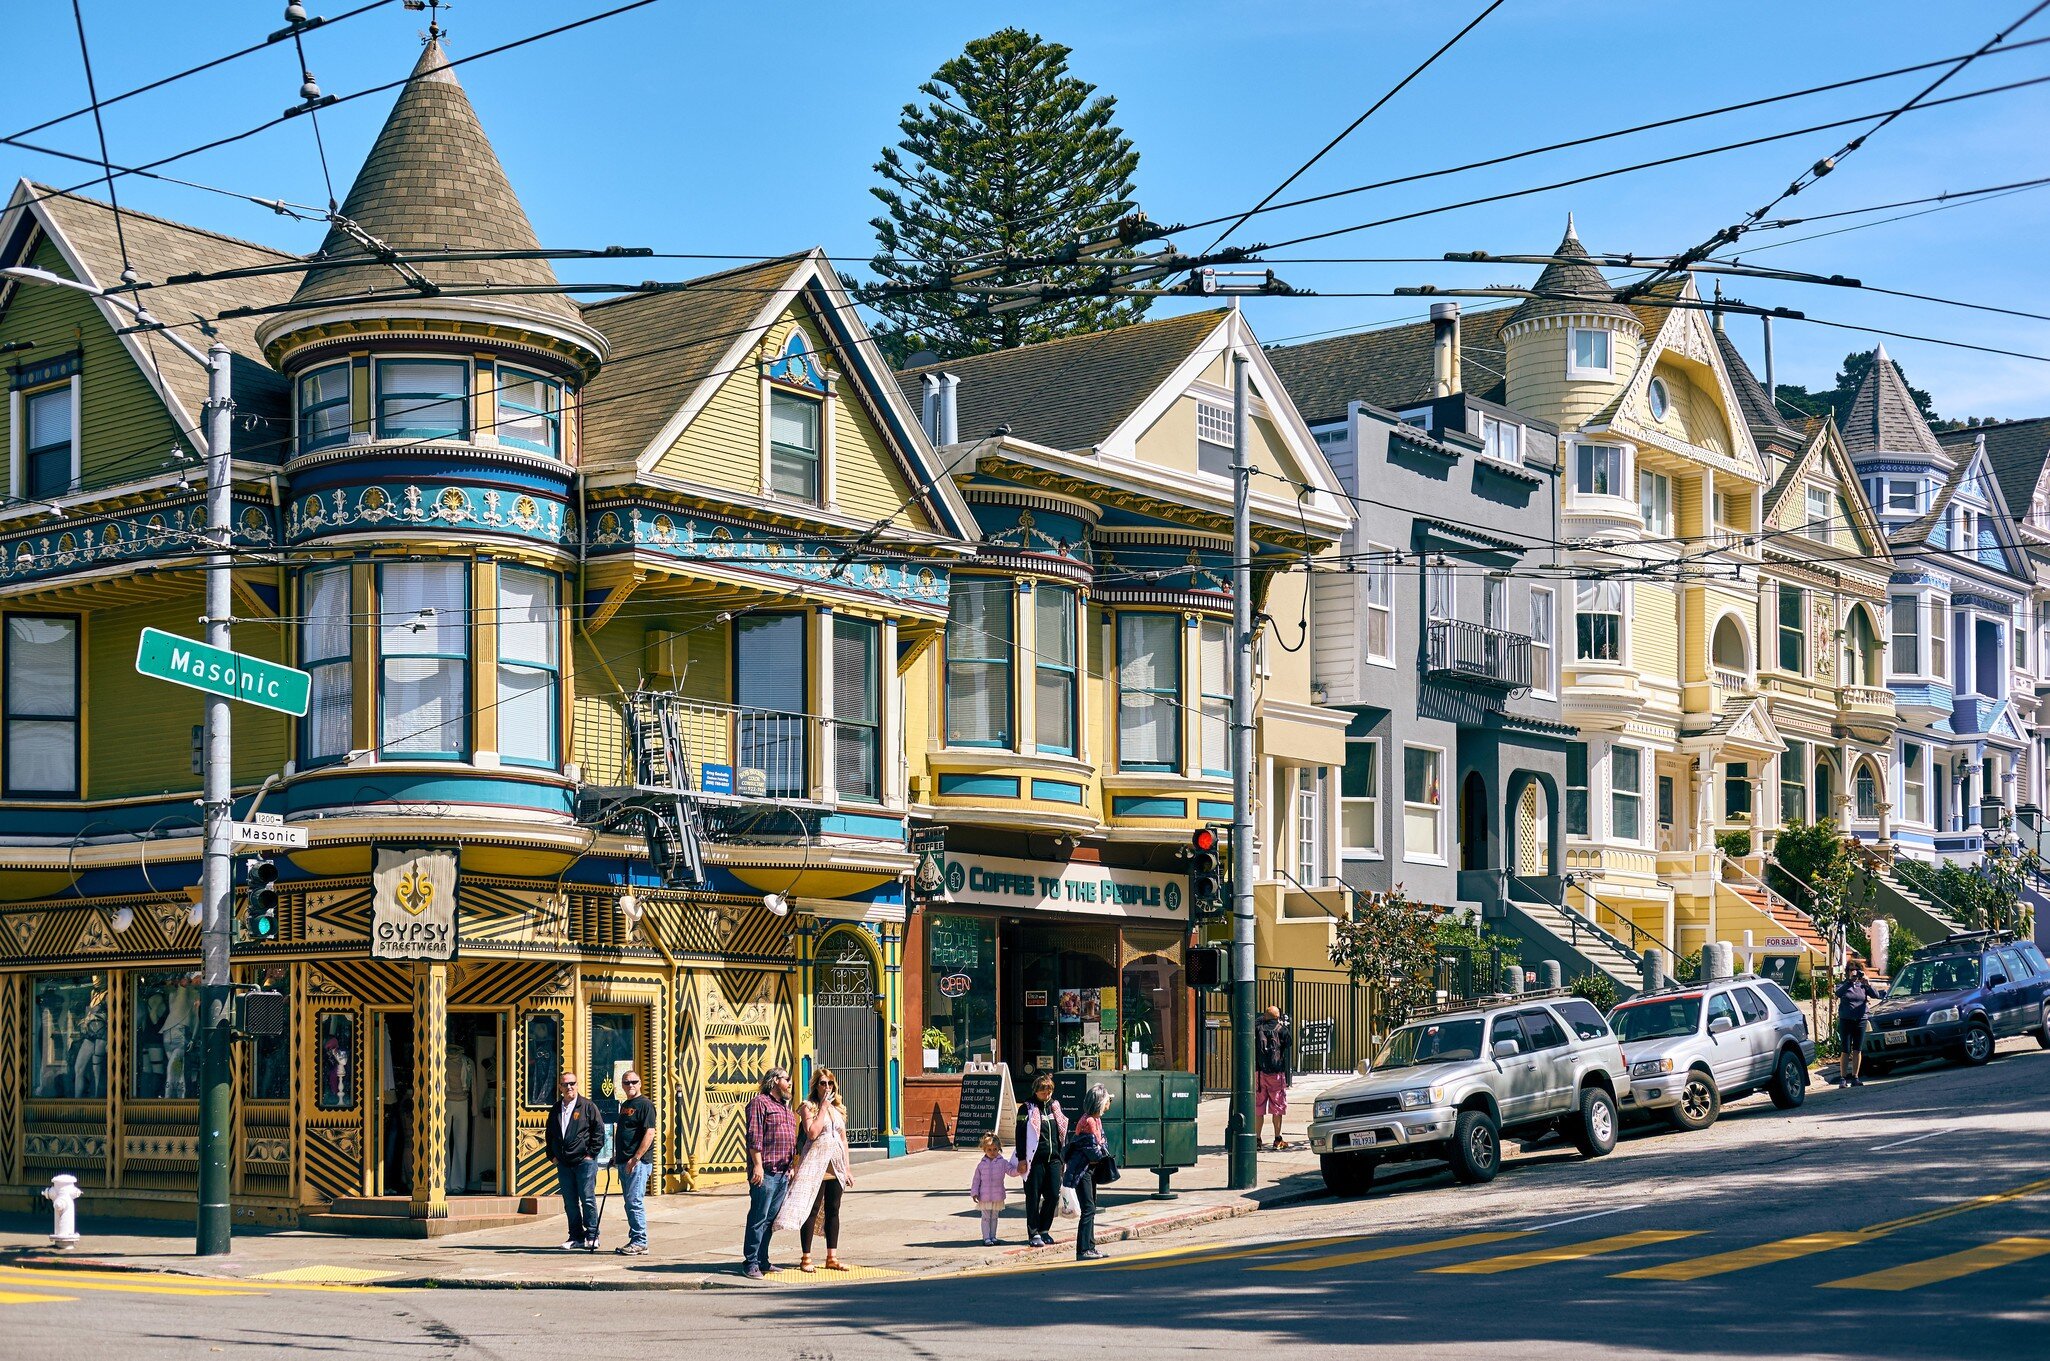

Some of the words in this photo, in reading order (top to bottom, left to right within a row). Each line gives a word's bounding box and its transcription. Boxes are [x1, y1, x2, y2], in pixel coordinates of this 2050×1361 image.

[170, 648, 280, 698] Masonic
[258, 814, 275, 824] 1200
[242, 827, 296, 842] Masonic
[915, 842, 943, 851] COFFEE
[917, 875, 944, 890] PEOPLE
[1065, 879, 1097, 901] THE
[378, 922, 449, 941] GYPSY
[937, 930, 953, 946] TO
[956, 931, 977, 948] THE
[379, 941, 448, 952] STREETWEAR
[1766, 938, 1780, 946] FOR
[1781, 938, 1799, 946] SALE
[933, 947, 979, 963] PEOPLE
[940, 976, 971, 991] OPEN
